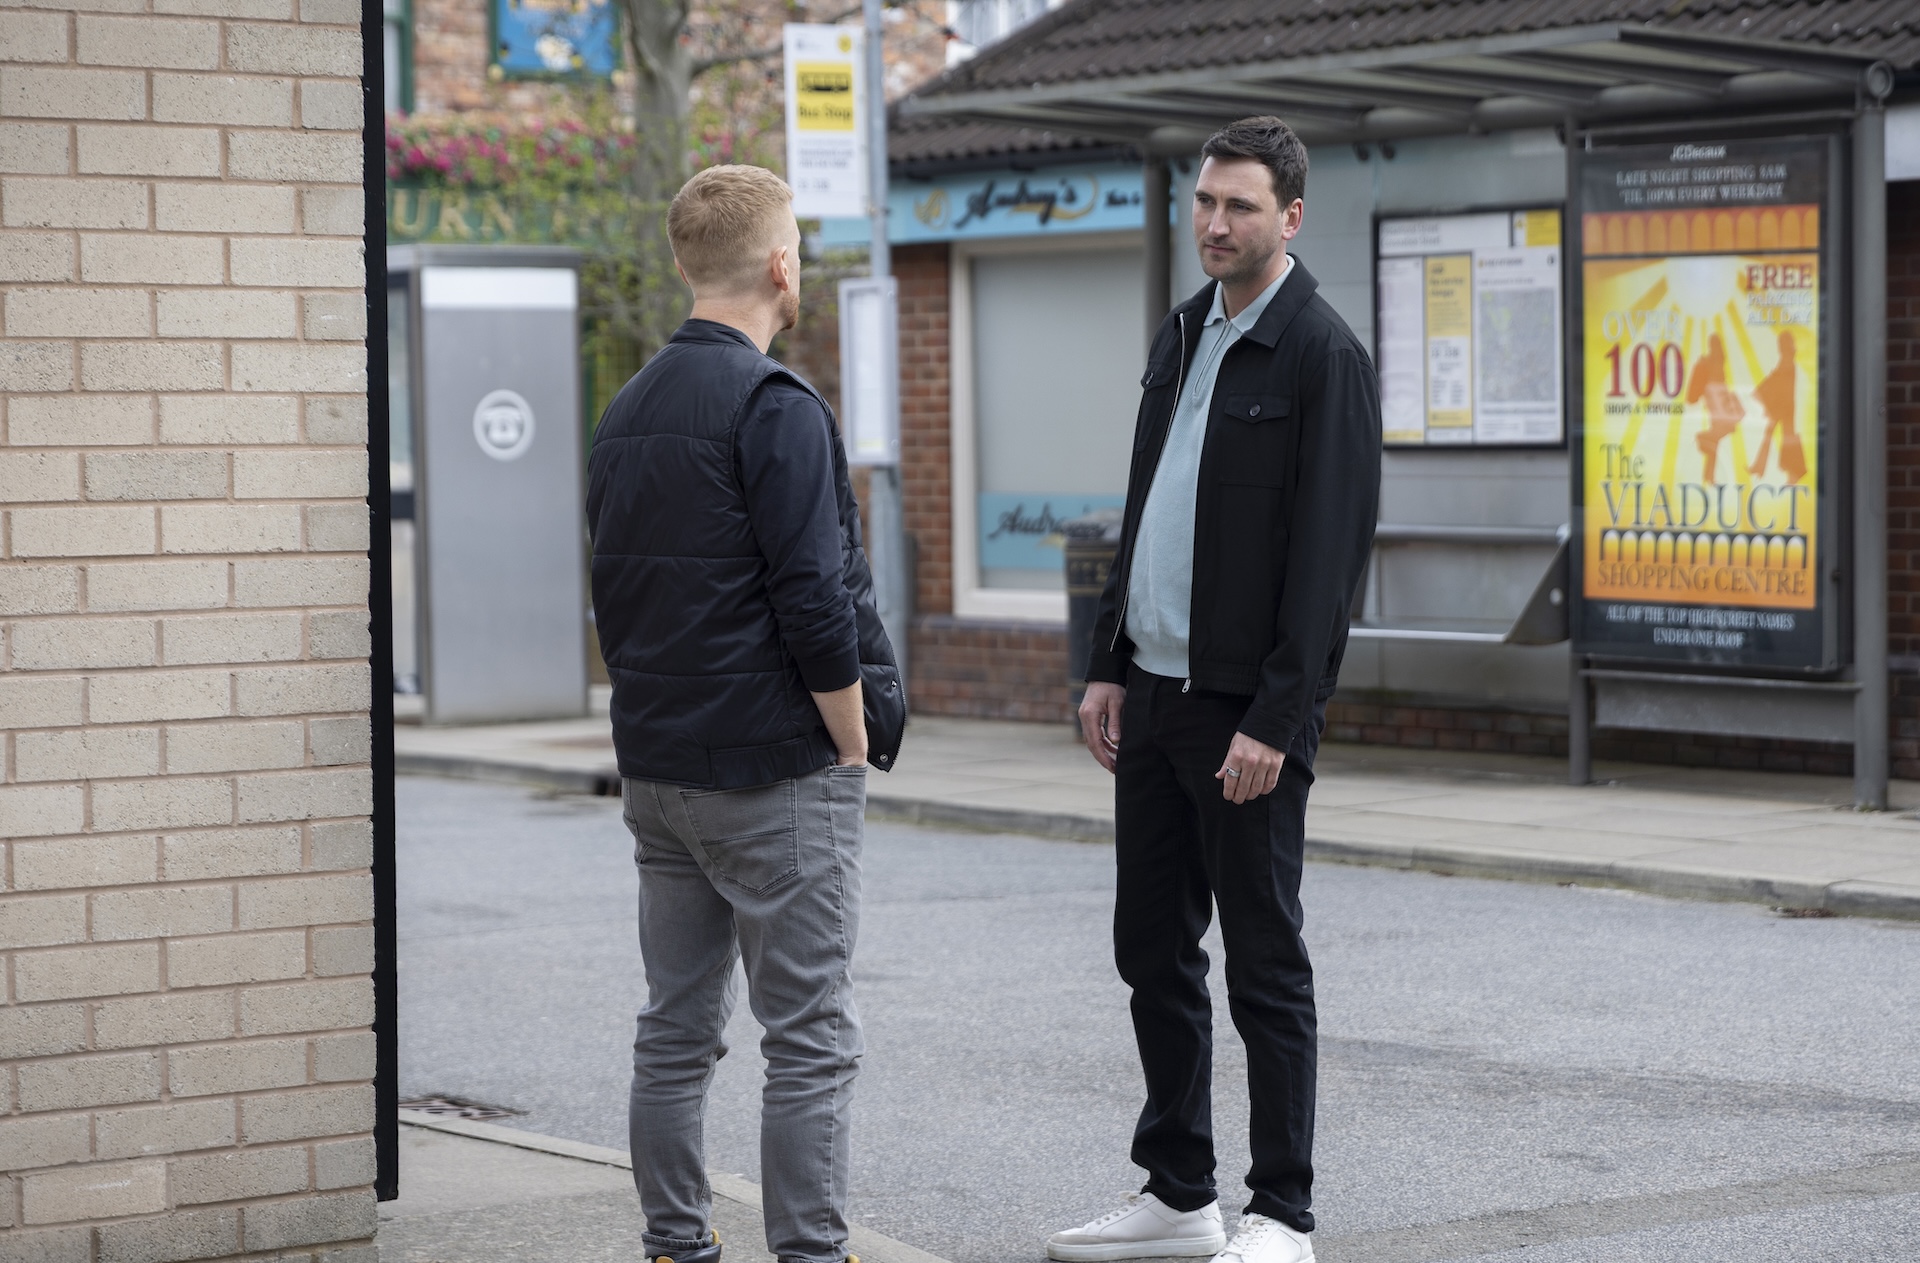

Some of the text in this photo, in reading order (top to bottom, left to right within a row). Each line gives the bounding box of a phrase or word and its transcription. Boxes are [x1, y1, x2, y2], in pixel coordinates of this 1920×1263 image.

[798, 103, 851, 122] Bus Stop
[1670, 144, 1727, 162] JCDecaux
[1616, 170, 1648, 186] LATE
[1650, 168, 1689, 184] NIGHT
[1691, 165, 1756, 182] SHOPPING
[1678, 185, 1718, 202] EVERY
[1719, 182, 1784, 199] WEEKDAY
[1745, 264, 1813, 290] FREE
[1747, 290, 1813, 307] PARKING
[1602, 310, 1683, 342] OVER
[1746, 308, 1813, 325] ALL DAY
[1604, 341, 1685, 399] 100
[1604, 402, 1632, 416] SHOPS
[1644, 402, 1684, 416] SERVICES
[1600, 443, 1645, 480] The
[1601, 481, 1810, 532] VIADUCT
[1598, 561, 1808, 595] SHOPPING CENTRE
[1606, 604, 1626, 621] ALL
[1627, 605, 1642, 623] OF
[1643, 606, 1665, 624] THE
[1667, 607, 1687, 625] TOP
[1757, 612, 1795, 631] NAMES
[1653, 627, 1746, 648] UNDER ONE ROOF
